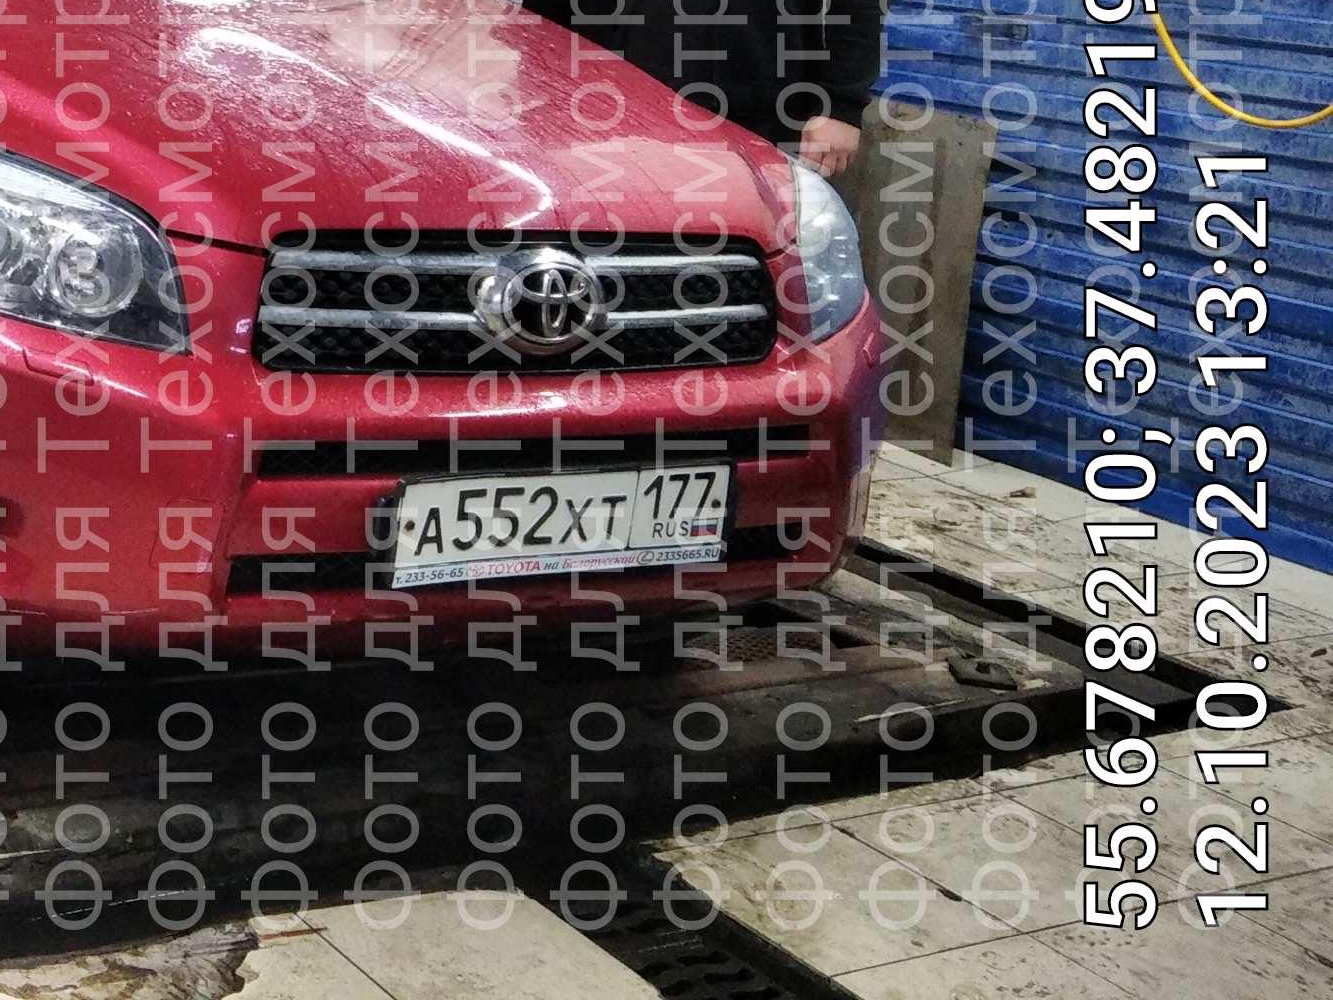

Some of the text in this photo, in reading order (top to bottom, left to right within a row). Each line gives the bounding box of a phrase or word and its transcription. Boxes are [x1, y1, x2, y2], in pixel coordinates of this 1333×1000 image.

[644, 472, 716, 519] 177
[652, 521, 689, 538] RUS
[405, 567, 464, 583] 233-56-65
[487, 560, 540, 576] TOYOTA
[544, 561, 558, 571] на
[655, 550, 718, 562] 2335665.RU
